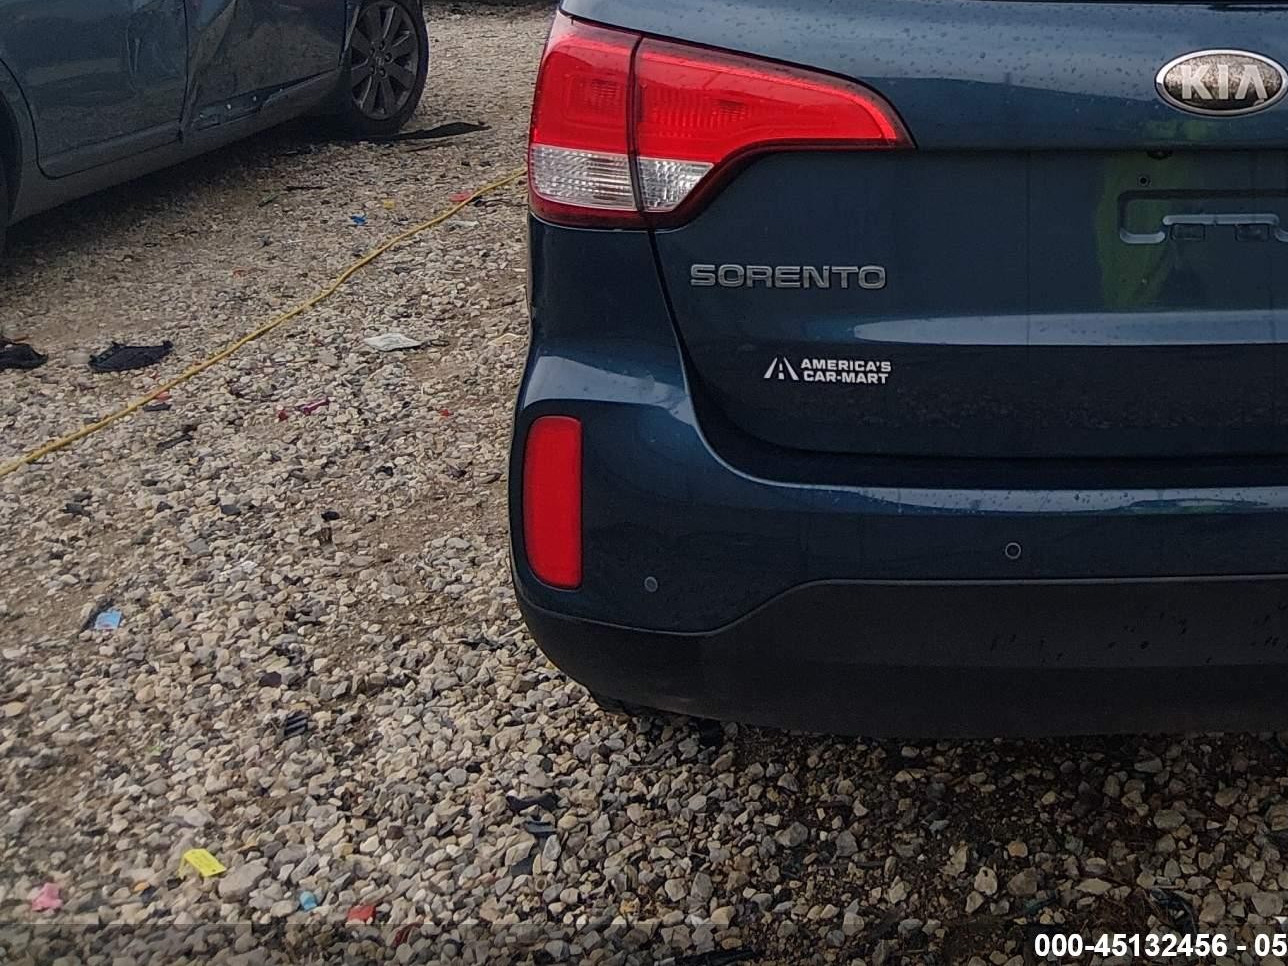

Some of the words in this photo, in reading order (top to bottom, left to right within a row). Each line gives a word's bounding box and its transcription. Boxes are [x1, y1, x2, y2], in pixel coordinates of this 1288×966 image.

[1180, 64, 1269, 100] KIA
[690, 263, 888, 290] SORENTO
[800, 358, 892, 372] AMERICA'S
[803, 370, 889, 384] CAR-MART
